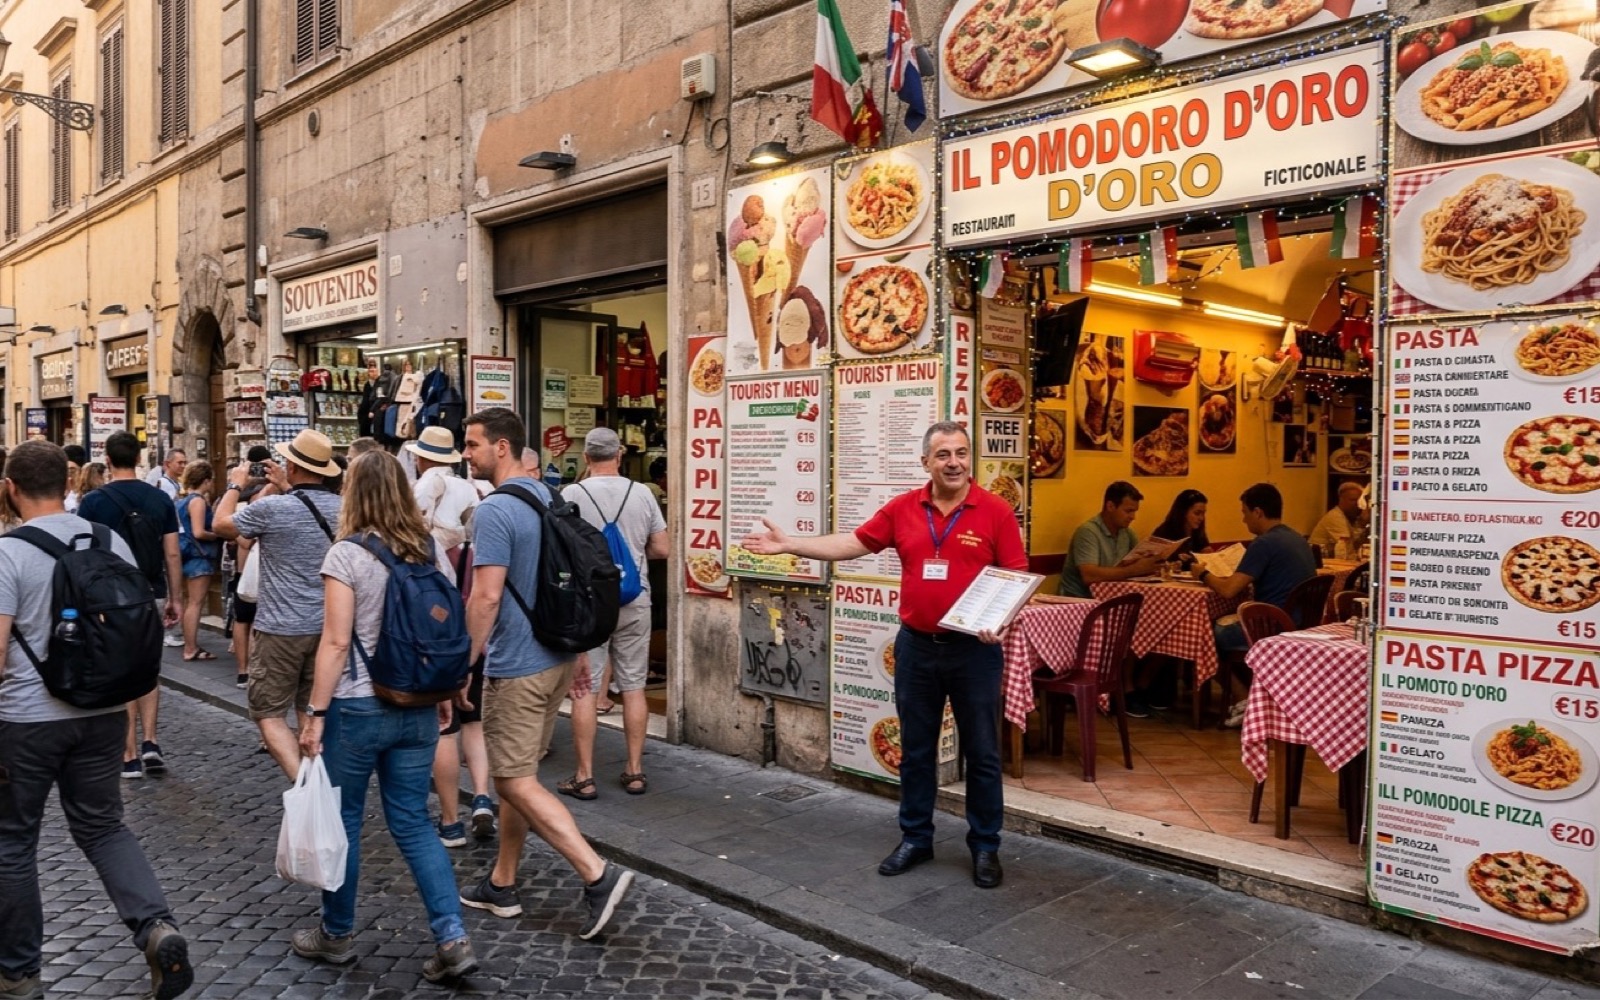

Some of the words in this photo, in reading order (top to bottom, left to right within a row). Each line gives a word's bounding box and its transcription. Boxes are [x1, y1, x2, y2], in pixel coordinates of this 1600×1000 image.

[951, 149, 981, 192] IL
[990, 98, 1210, 185] POMODORO
[1224, 64, 1370, 140] D’ORO
[1263, 155, 1367, 188] FICTICONALE
[696, 184, 710, 202] 15
[1048, 152, 1223, 222] D’ORO
[285, 266, 377, 314] SOUVENIRS
[1395, 327, 1479, 350] PASTA
[1414, 358, 1442, 366] PASTA
[839, 365, 892, 384] TOURIST
[896, 362, 936, 381] MENU
[1414, 373, 1442, 382] PASTA
[730, 382, 780, 400] TOURIST
[784, 380, 819, 398] MENU
[1414, 388, 1442, 398] PASTA
[1563, 386, 1600, 404] €15
[1413, 404, 1442, 414] PASTA
[986, 420, 1020, 436] FREE
[1412, 420, 1442, 429] PASTA
[1453, 420, 1480, 429] PIZZA
[691, 438, 724, 458] ST
[987, 438, 1016, 454] WIFI
[1412, 436, 1442, 444] PASTA
[1453, 436, 1480, 444] PIZZA
[1442, 451, 1469, 460] PIZZA
[797, 460, 815, 472] €20
[797, 491, 814, 502] €20
[1561, 511, 1600, 528] €20
[1458, 534, 1485, 544] PIZZA
[1410, 579, 1438, 588] PASTA
[836, 584, 884, 606] PASTA
[1557, 620, 1596, 639] €15
[1386, 640, 1486, 676] PASTA
[1498, 652, 1600, 689] PIZZA
[1382, 673, 1394, 688] IL
[1398, 676, 1458, 696] POMOTO
[1555, 697, 1598, 718] €15
[1400, 746, 1444, 760] GELATO
[1378, 782, 1399, 800] ILL
[1404, 787, 1490, 818] POMODOLE
[1496, 804, 1544, 828] PIZZA
[1551, 823, 1595, 846] €20
[1395, 868, 1438, 884] GELATO
